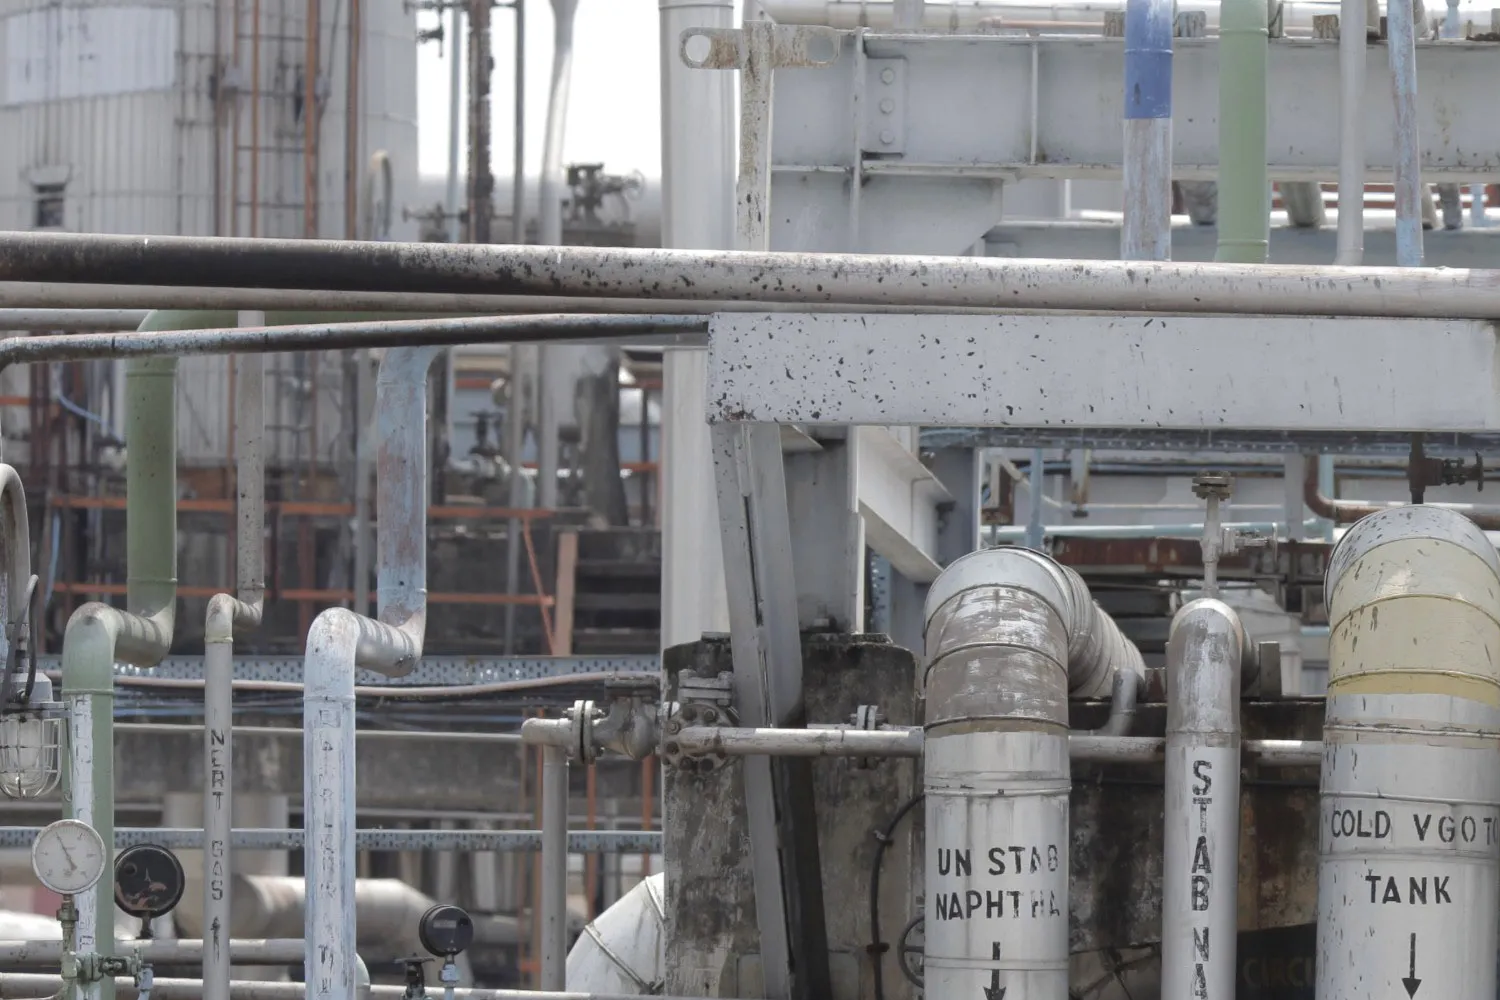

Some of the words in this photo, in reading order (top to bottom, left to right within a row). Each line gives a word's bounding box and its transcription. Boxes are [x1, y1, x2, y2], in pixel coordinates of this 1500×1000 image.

[1191, 760, 1213, 911] STAB
[1331, 809, 1392, 839] COLD
[211, 841, 223, 900] GAS
[937, 848, 972, 877] UN
[988, 844, 1059, 876] STAB
[936, 889, 1060, 920] NAPHTHA
[1365, 875, 1452, 905] TANK
